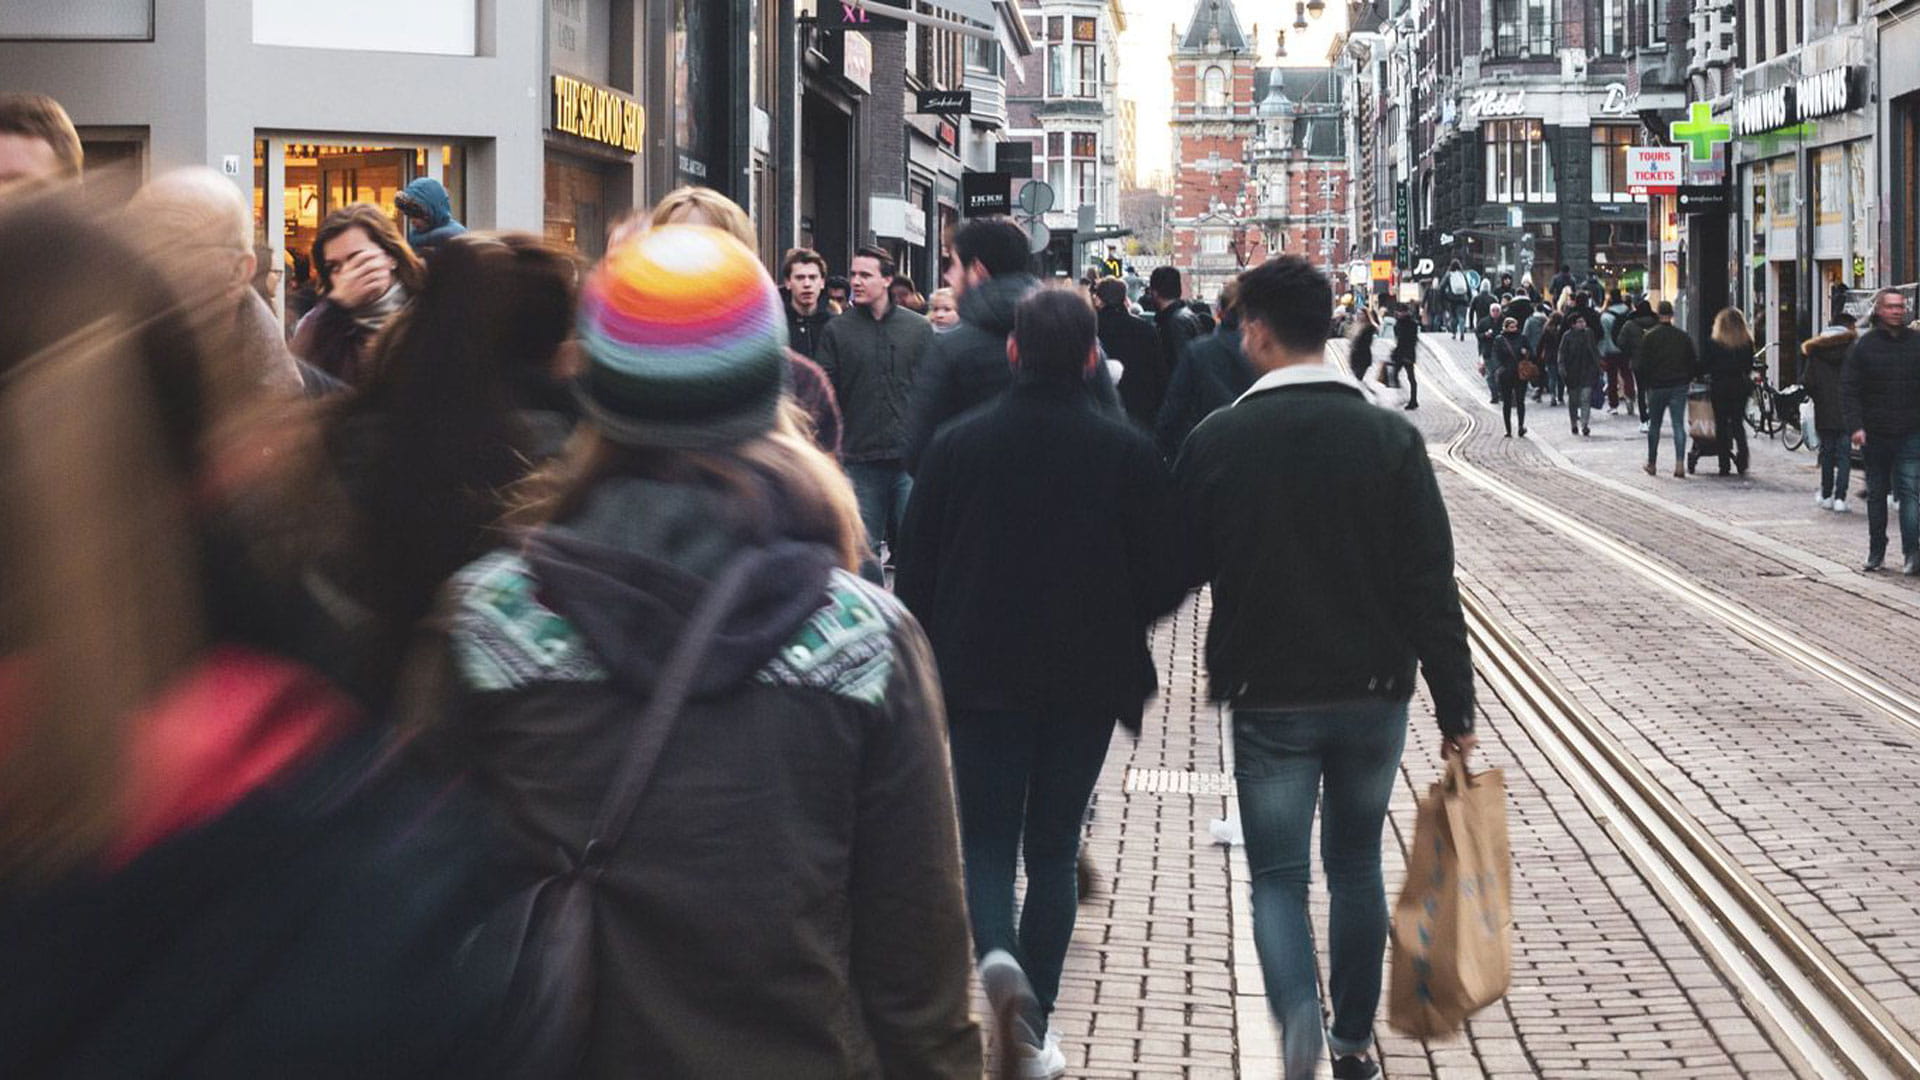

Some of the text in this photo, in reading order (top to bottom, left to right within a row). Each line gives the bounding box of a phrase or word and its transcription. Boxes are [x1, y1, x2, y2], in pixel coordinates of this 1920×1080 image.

[842, 5, 870, 23] XL
[1822, 64, 1847, 114] VOUS
[1468, 90, 1525, 117] Hotel
[555, 75, 645, 153] THE SEAFOOD SHOP
[1638, 152, 1671, 162] TOURS
[1649, 162, 1658, 171] &
[1634, 171, 1675, 181] TICKETS
[1413, 258, 1434, 275] JD
